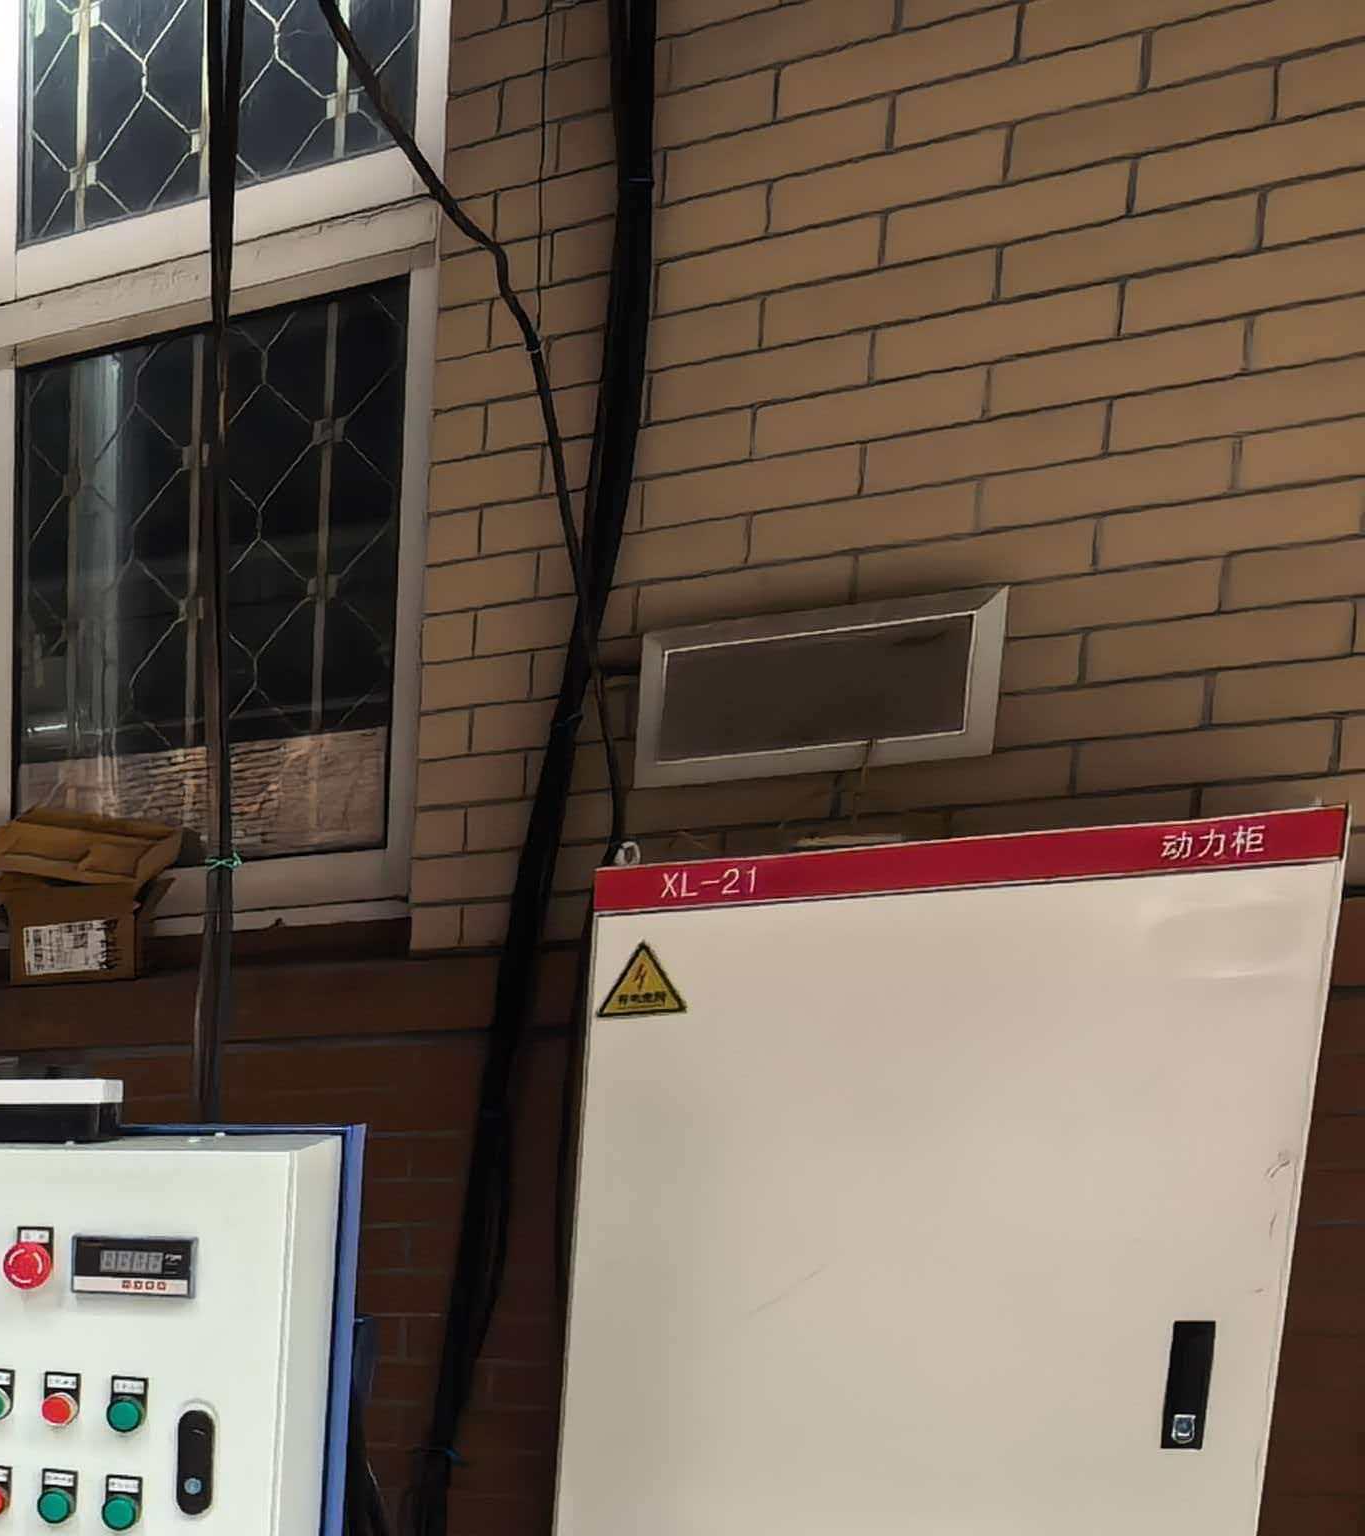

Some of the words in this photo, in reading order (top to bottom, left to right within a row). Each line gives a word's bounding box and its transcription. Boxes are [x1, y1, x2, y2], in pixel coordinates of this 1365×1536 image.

[1160, 825, 1266, 859] 动力柜
[660, 866, 757, 898] XL-21
